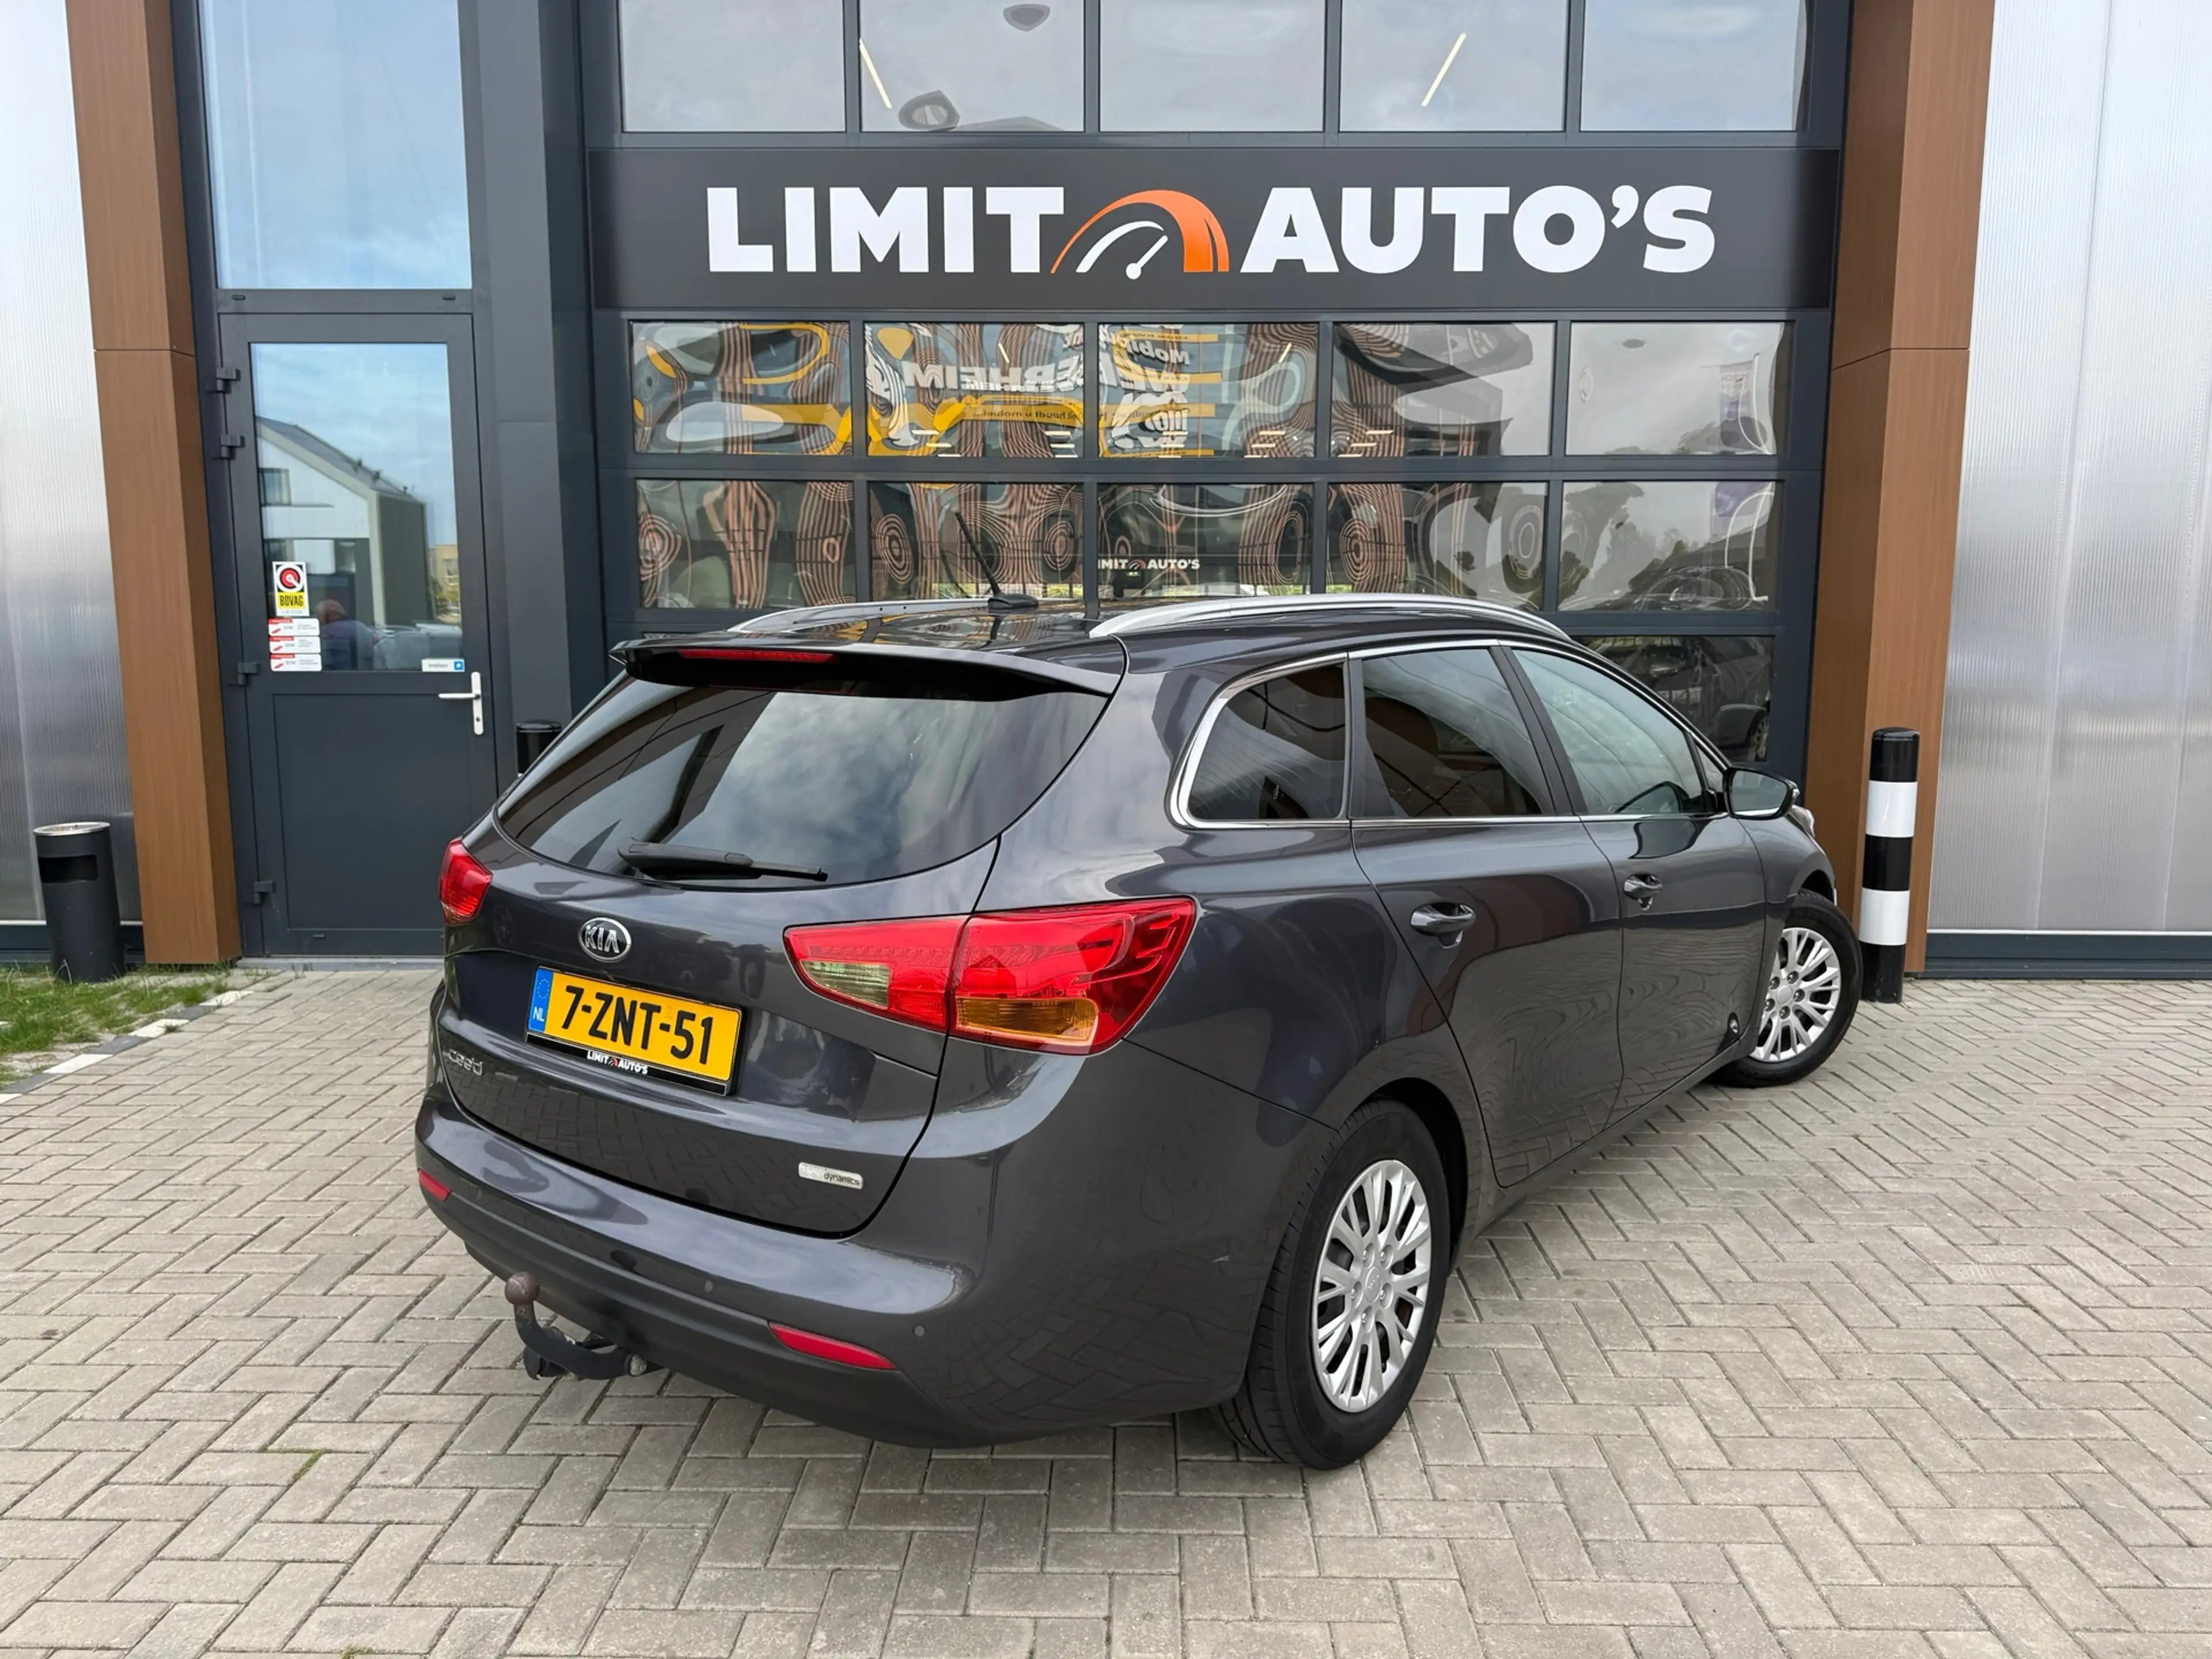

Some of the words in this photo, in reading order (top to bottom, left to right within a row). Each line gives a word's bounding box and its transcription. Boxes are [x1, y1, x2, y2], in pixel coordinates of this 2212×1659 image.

[707, 187, 1064, 272] LIMIT
[1240, 185, 1715, 273] AUTO'S
[1098, 559, 1129, 569] IMIT
[1147, 558, 1200, 570] AUTO'S
[279, 594, 304, 607] BOVAG
[585, 925, 620, 953] KIA
[532, 1006, 545, 1022] NL
[561, 985, 714, 1065] 7-ZNT-51
[587, 1050, 609, 1065] LIMIT
[618, 1059, 648, 1075] AUTO'S
[824, 1172, 861, 1185] dynamics
